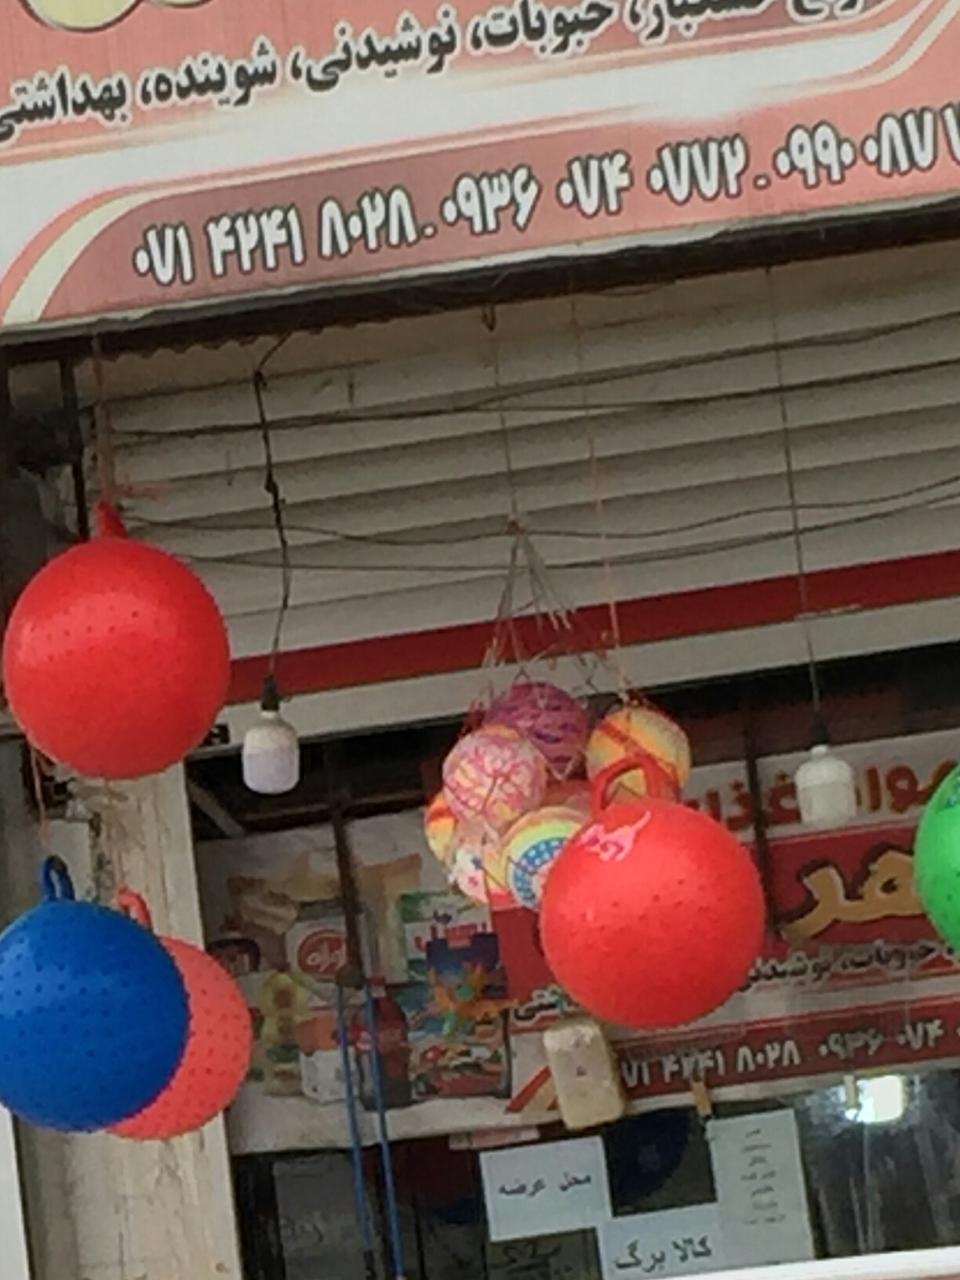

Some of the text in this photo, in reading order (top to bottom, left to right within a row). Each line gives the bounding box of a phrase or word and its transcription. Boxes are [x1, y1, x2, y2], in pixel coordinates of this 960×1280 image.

[292, 9, 459, 88] نوشیدنی،
[471, 0, 614, 55] حبوبات،
[141, 38, 278, 106] شوینده،
[134, 224, 195, 285] ۰۷۱
[205, 205, 304, 277] ۴۲۴۱
[442, 164, 540, 234] ۰۹۳۶
[556, 151, 632, 216] ۰۷۴
[671, 1236, 712, 1263] کالا
